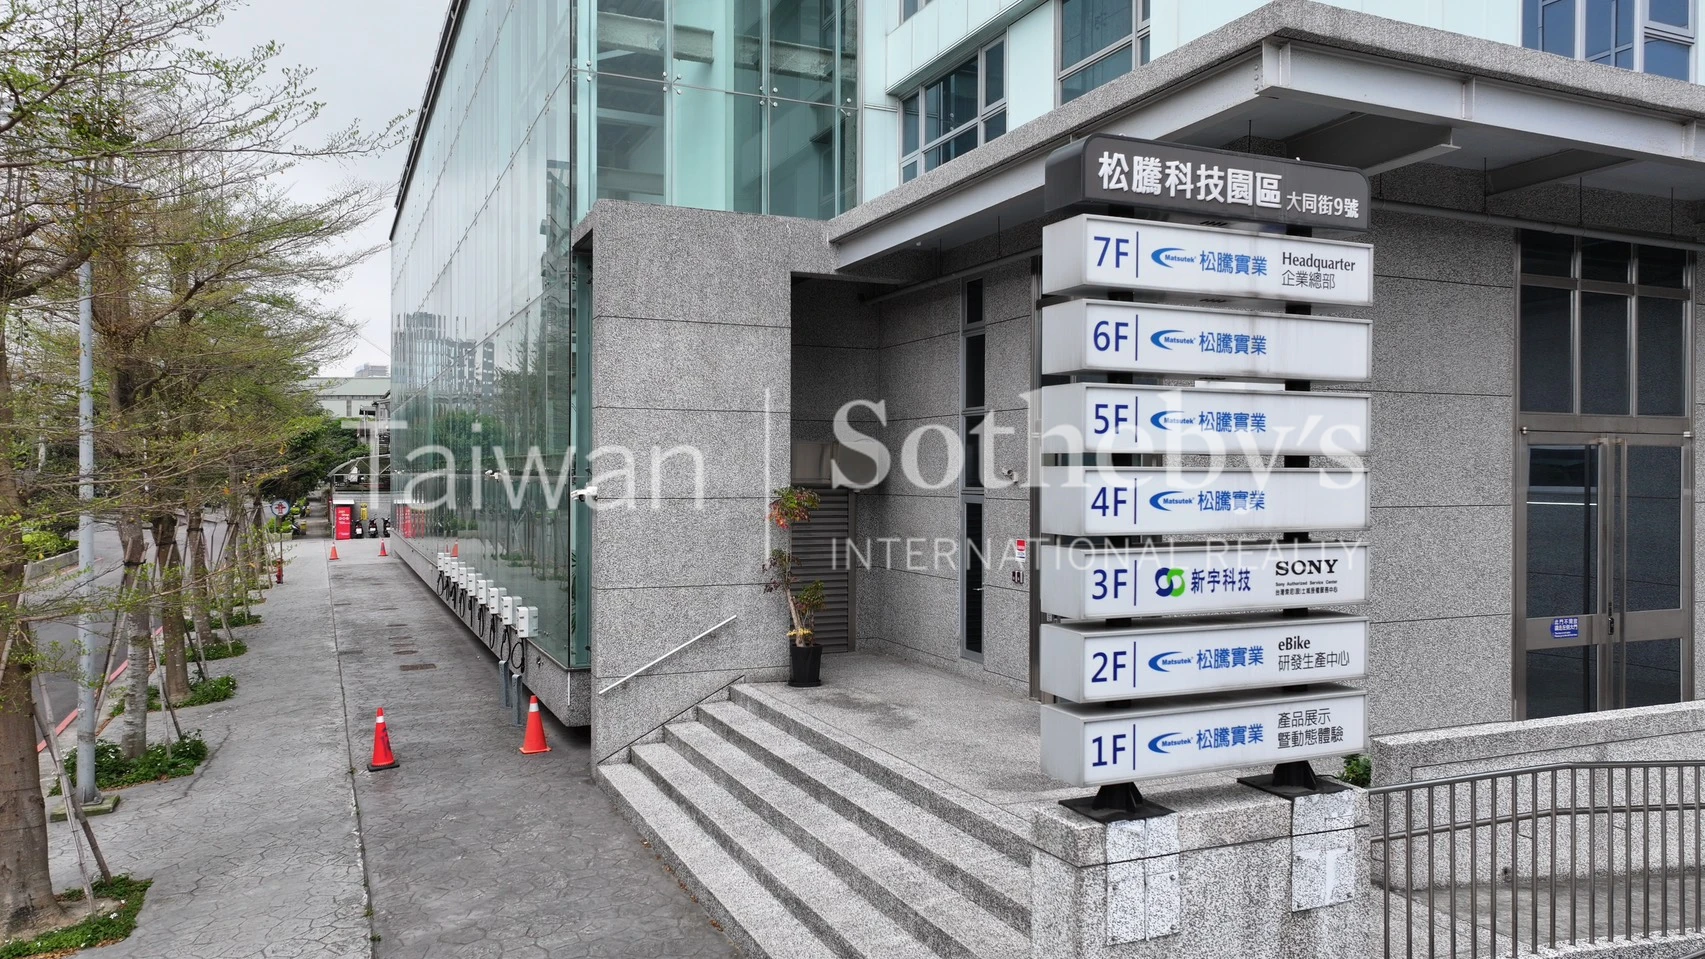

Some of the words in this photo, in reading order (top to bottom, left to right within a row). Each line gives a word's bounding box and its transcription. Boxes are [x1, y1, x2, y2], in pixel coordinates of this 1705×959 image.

[1097, 151, 1283, 209] 松騰科技園區
[1286, 191, 1360, 219] 大同街9號
[1093, 236, 1130, 268] 7F
[1164, 254, 1195, 263] Matsutek
[1199, 250, 1268, 276] 松騰實業
[1282, 251, 1356, 272] Headquarter
[1281, 269, 1336, 290] 企業總部
[1093, 320, 1129, 352] 6F
[1163, 336, 1194, 345] Matsutek
[1199, 331, 1267, 356] 松騰實業
[1094, 403, 1129, 435] 5F
[1198, 410, 1267, 433] 松騰實業
[1090, 486, 1128, 517] 4F
[1162, 497, 1193, 505] Matsutek
[1197, 490, 1266, 512] 松騰實業
[1275, 559, 1338, 576] SONY
[1092, 569, 1128, 600] 3F
[1190, 567, 1251, 594] 新宇科技
[1278, 635, 1311, 651] eBike
[1091, 651, 1127, 683] 2F
[1161, 658, 1192, 666] Matsutek
[1196, 645, 1264, 670] 松騰實業
[1278, 650, 1350, 672] 研發生產中心
[1277, 707, 1331, 729] 產品展示
[1092, 734, 1127, 767] 1F
[1161, 739, 1192, 747] Matsutek
[1196, 723, 1264, 750] 松騰實業
[1277, 726, 1344, 750] 暨動態體驗
